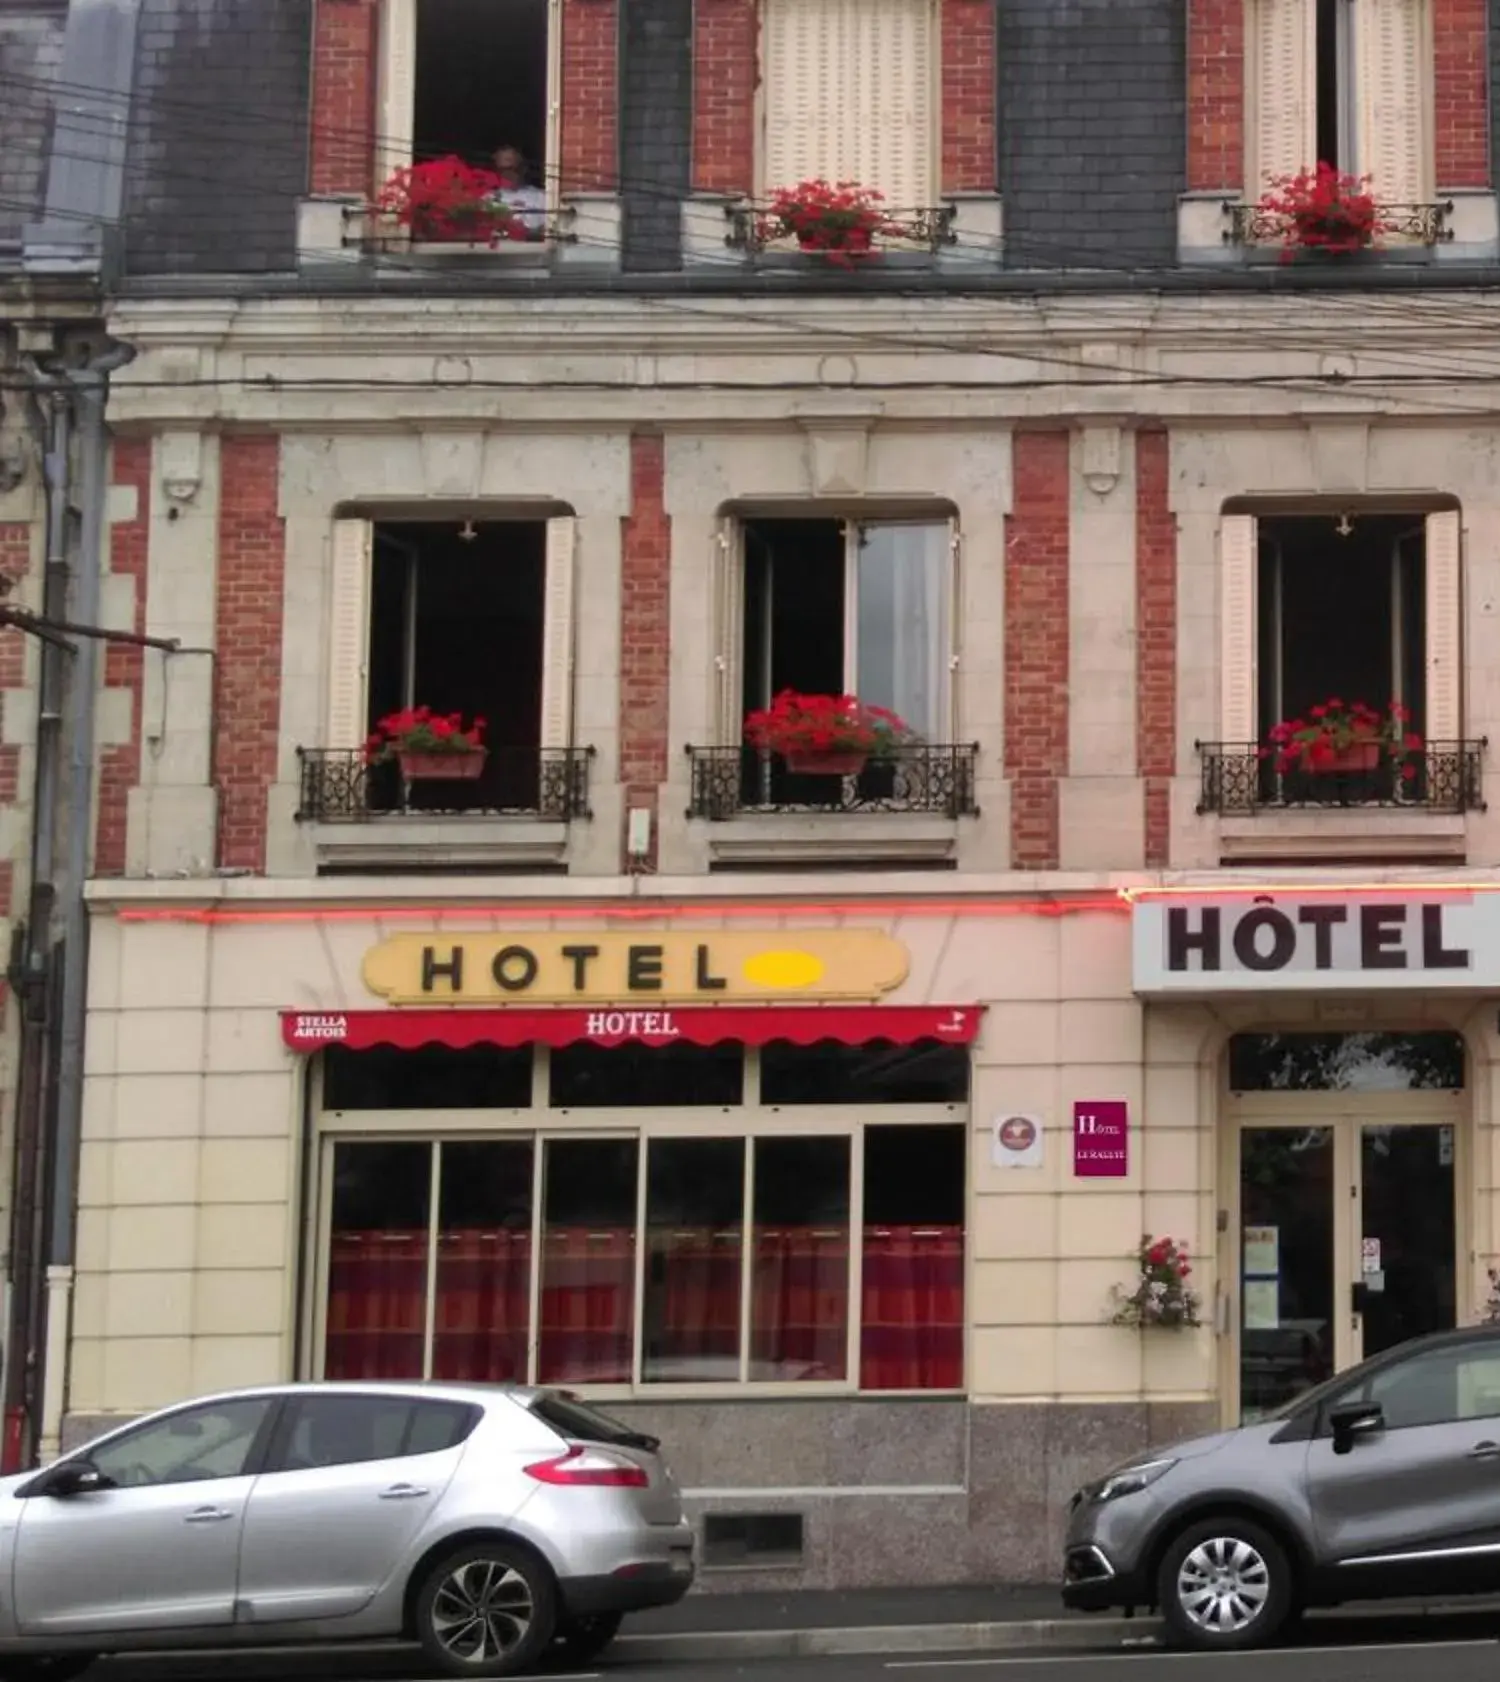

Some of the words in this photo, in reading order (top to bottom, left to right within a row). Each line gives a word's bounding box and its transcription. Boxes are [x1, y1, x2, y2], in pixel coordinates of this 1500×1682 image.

[1167, 895, 1469, 971] HÔTEL
[421, 944, 727, 993] HOTEL
[294, 1026, 346, 1038] ARTOIS
[296, 1015, 347, 1027] STELLA
[586, 1011, 680, 1036] HOTEL
